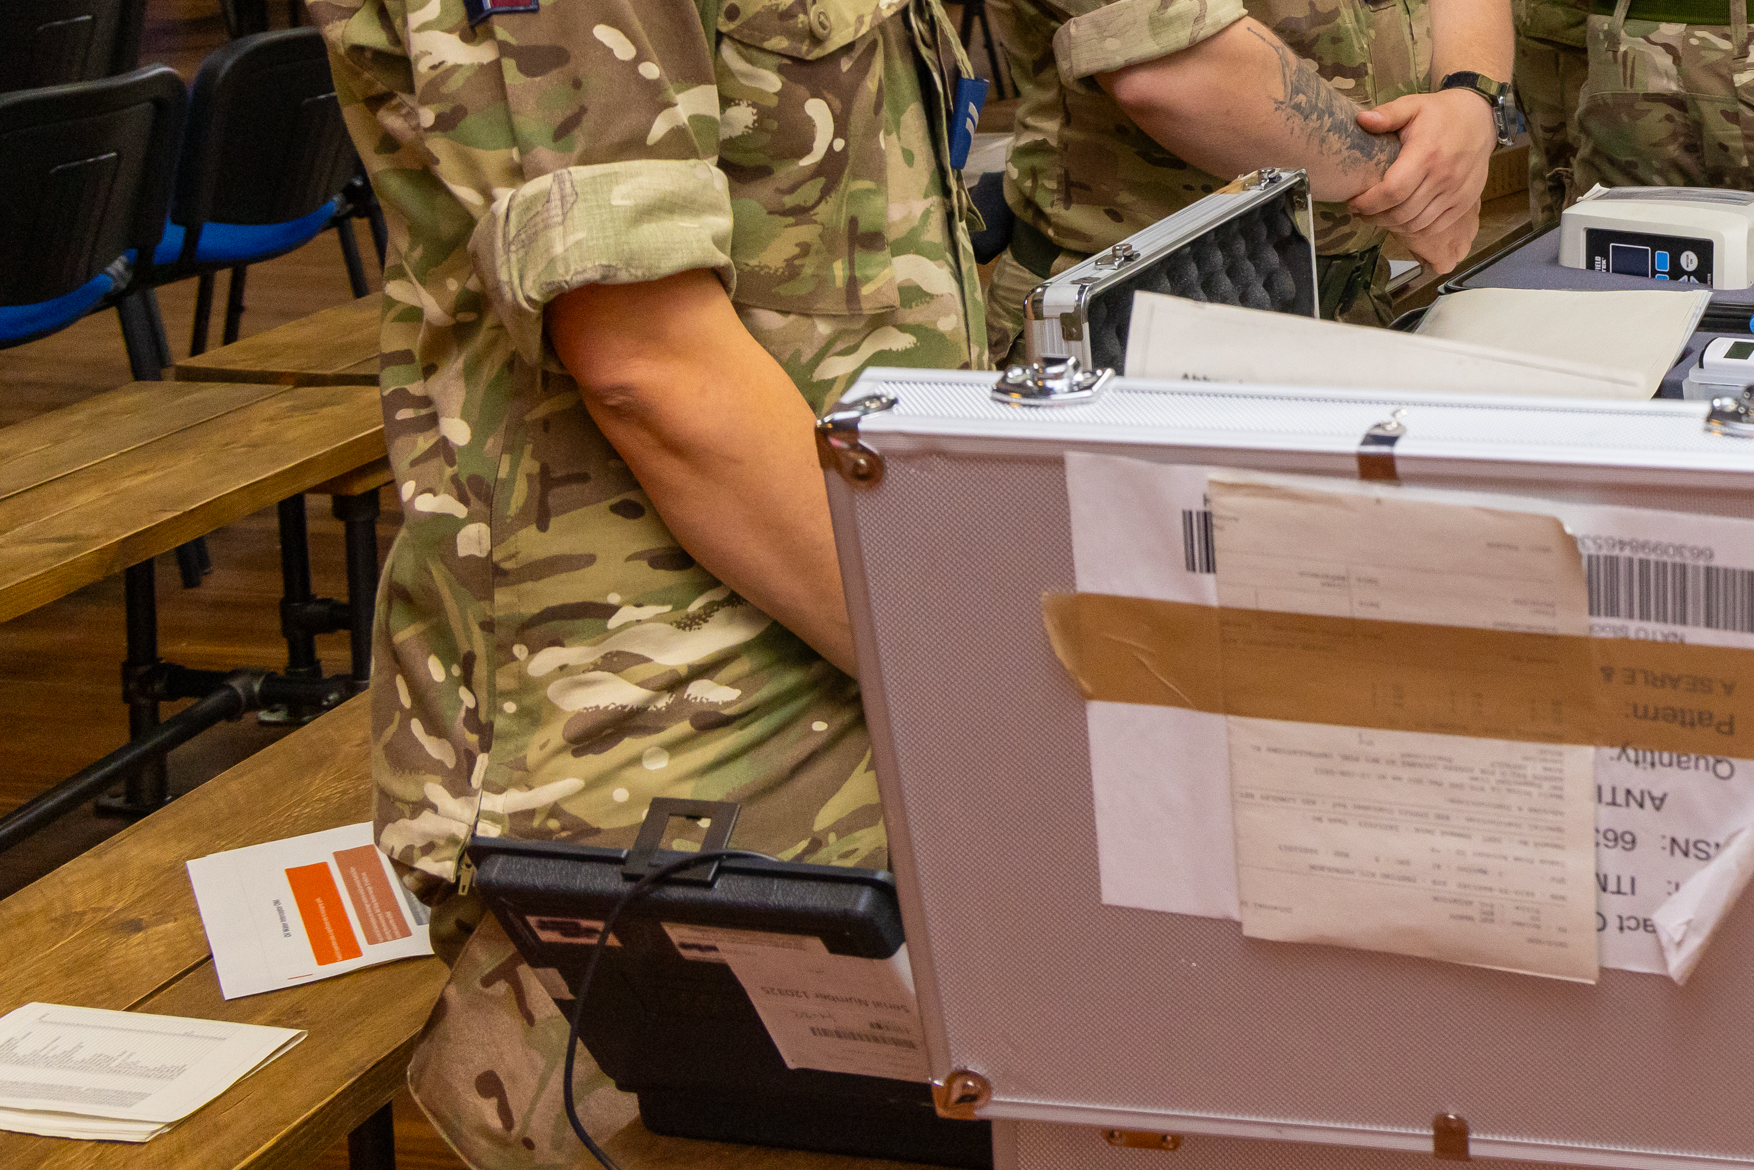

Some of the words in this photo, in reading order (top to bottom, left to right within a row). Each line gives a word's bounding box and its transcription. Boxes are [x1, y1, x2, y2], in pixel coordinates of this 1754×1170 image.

[1600, 664, 1615, 684] &
[1622, 667, 1714, 695] SEARLE
[1720, 680, 1737, 697] A
[1624, 702, 1736, 736] Pattern:
[1609, 742, 1736, 780] Quantity:
[1597, 784, 1669, 812] ANTI
[814, 992, 869, 1007] Number
[872, 1000, 910, 1014] Serial
